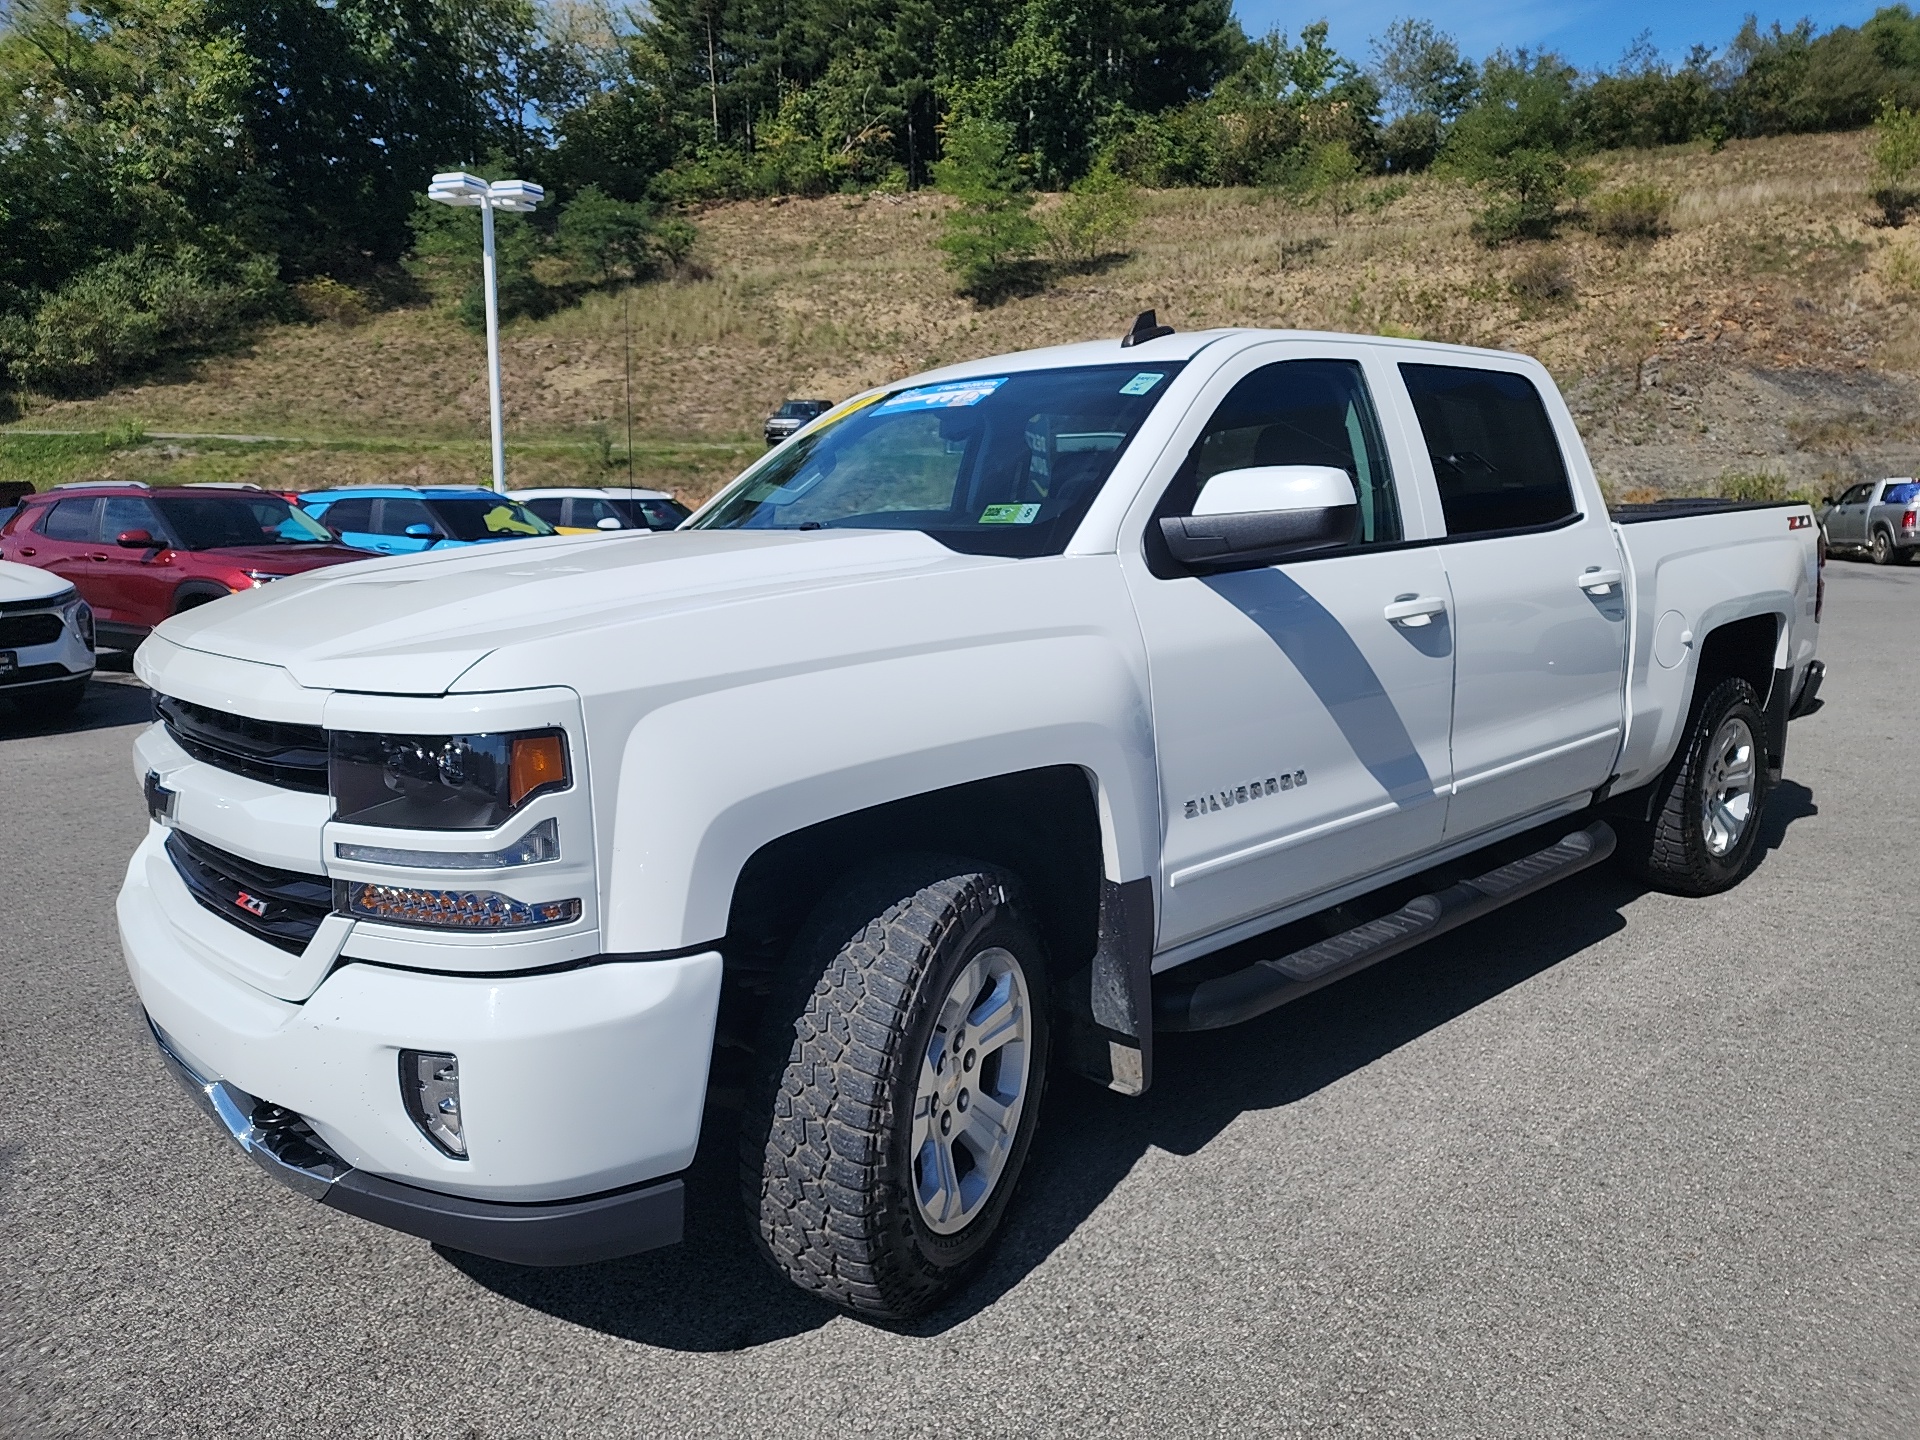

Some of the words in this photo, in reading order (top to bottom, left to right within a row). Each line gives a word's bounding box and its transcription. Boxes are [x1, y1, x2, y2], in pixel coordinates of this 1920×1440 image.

[1787, 514, 1813, 531] Z71
[1183, 769, 1308, 820] SILVERADO
[235, 891, 268, 917] Z71
